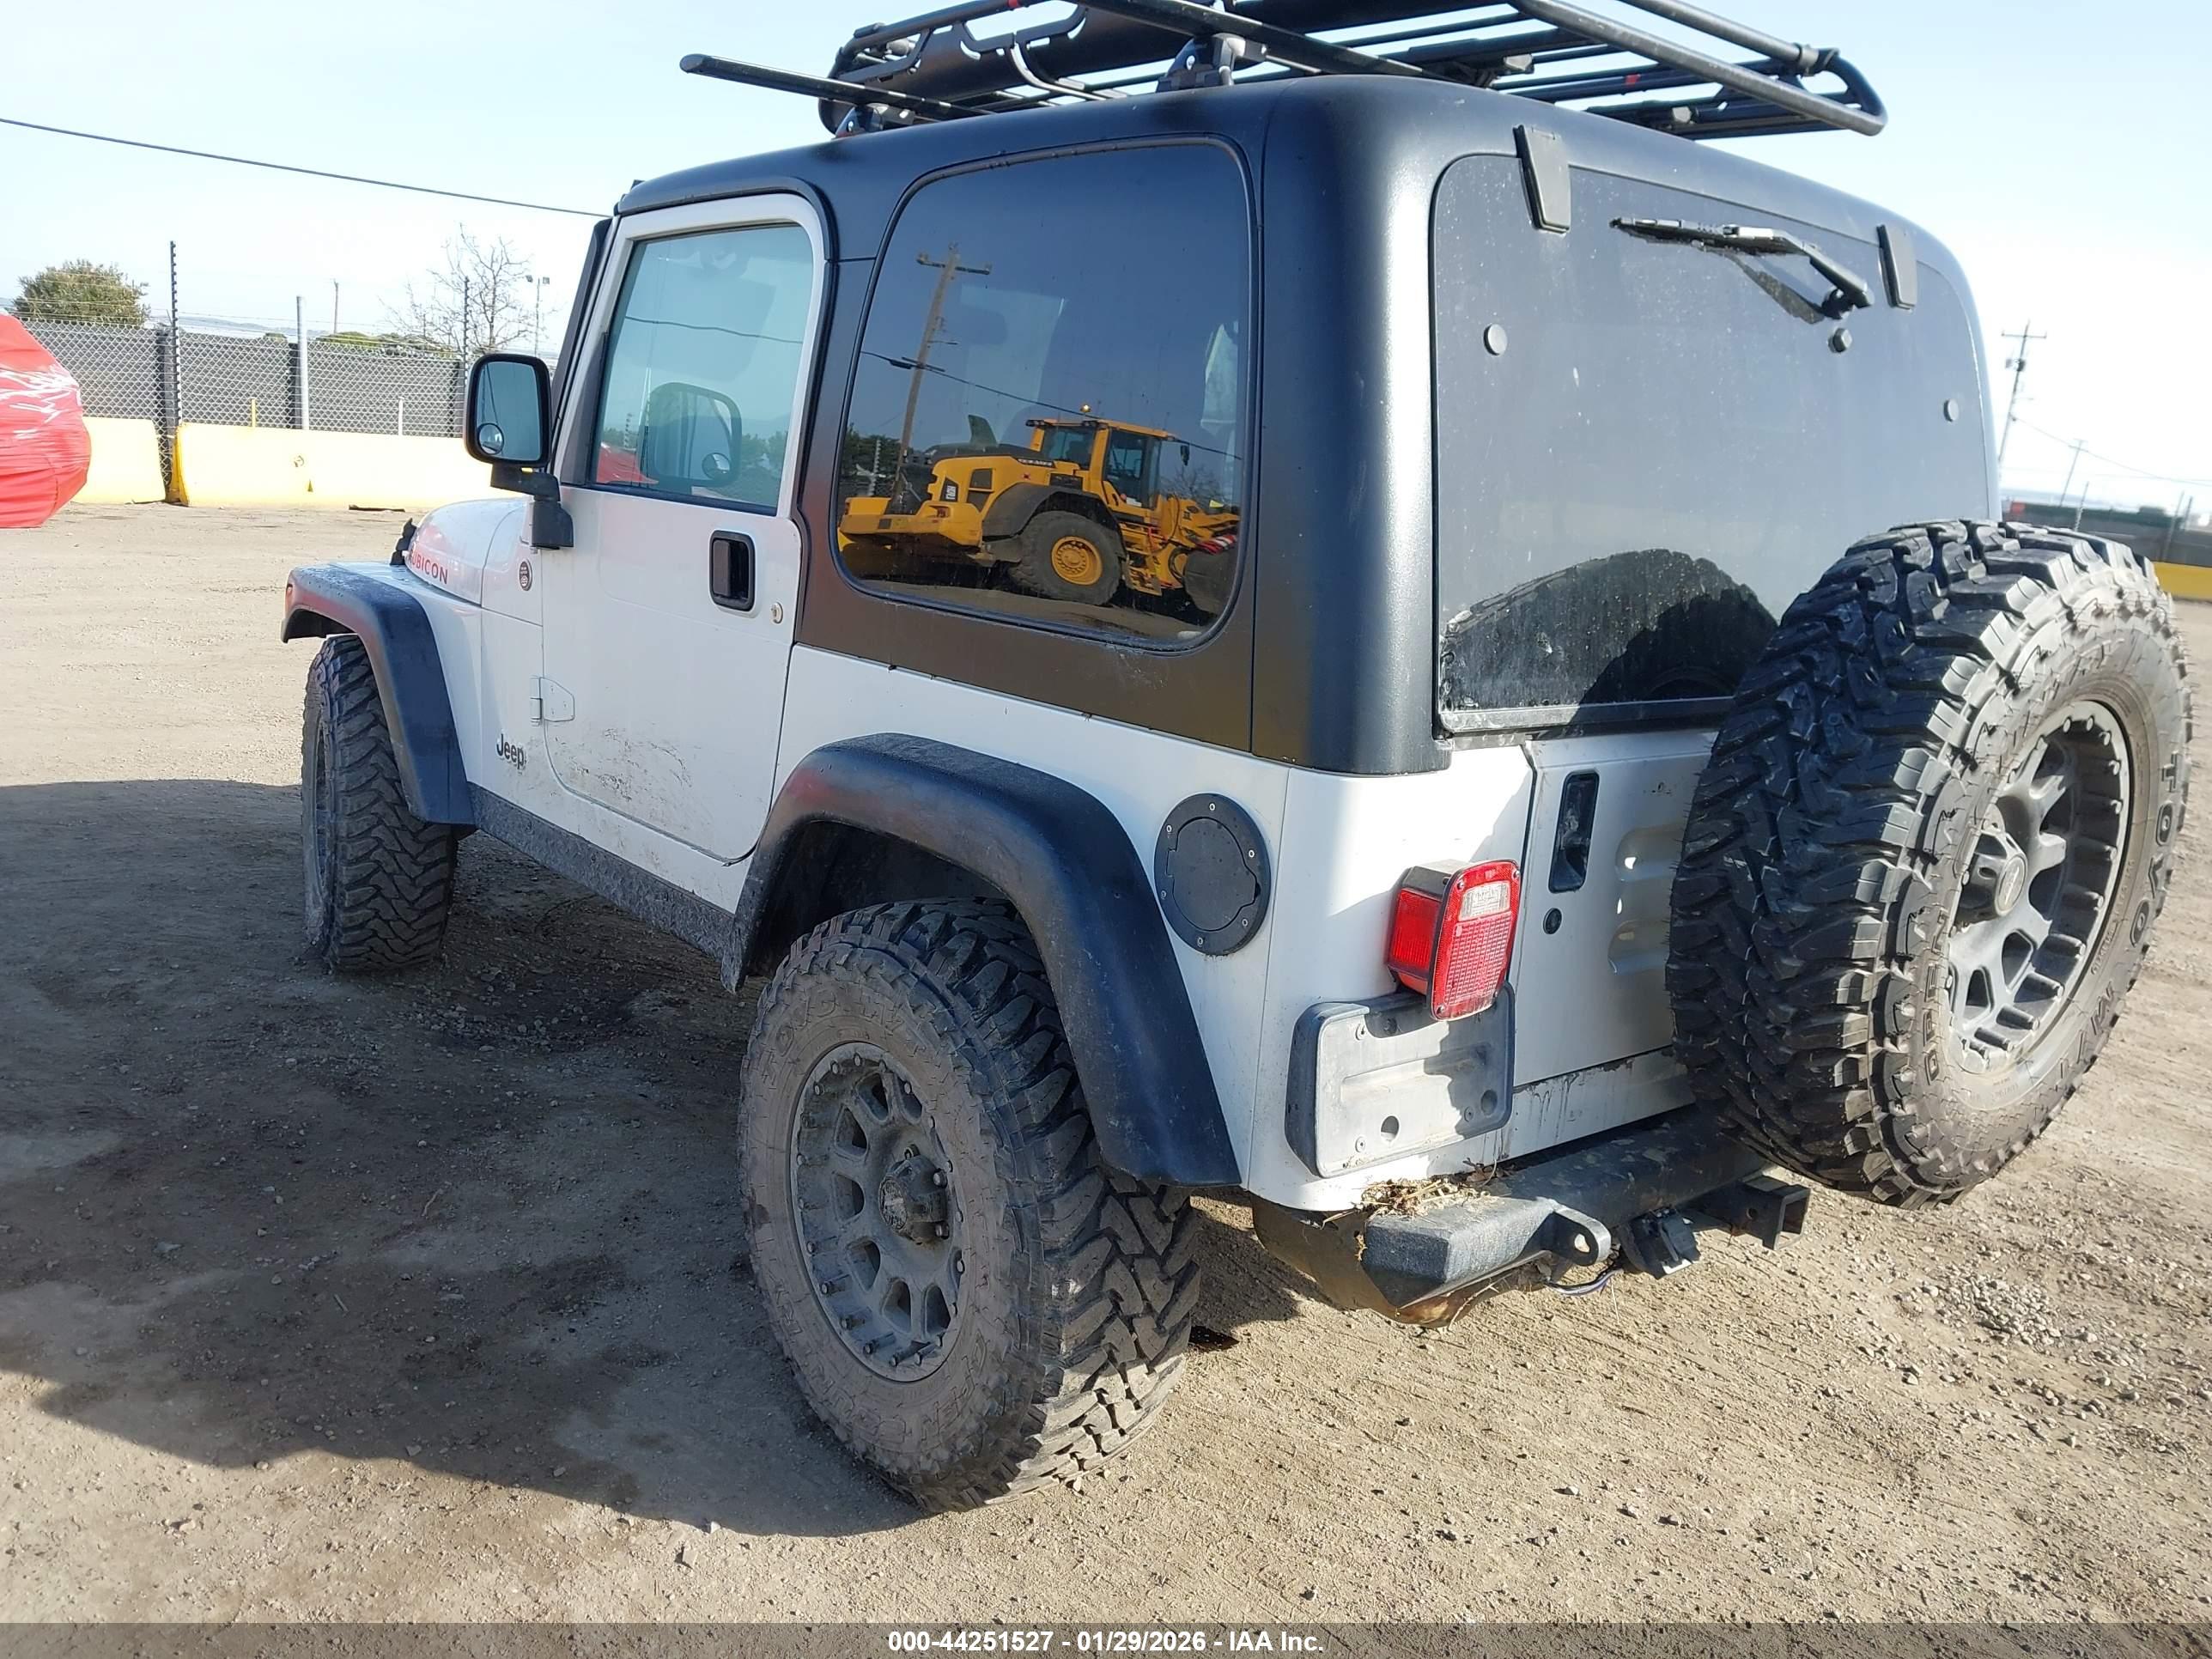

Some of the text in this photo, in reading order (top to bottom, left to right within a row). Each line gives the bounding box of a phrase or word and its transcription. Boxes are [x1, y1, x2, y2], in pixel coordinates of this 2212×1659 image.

[409, 553, 447, 585] RUBICON
[496, 732, 525, 770] Jeep
[2130, 750, 2179, 947] TOYO
